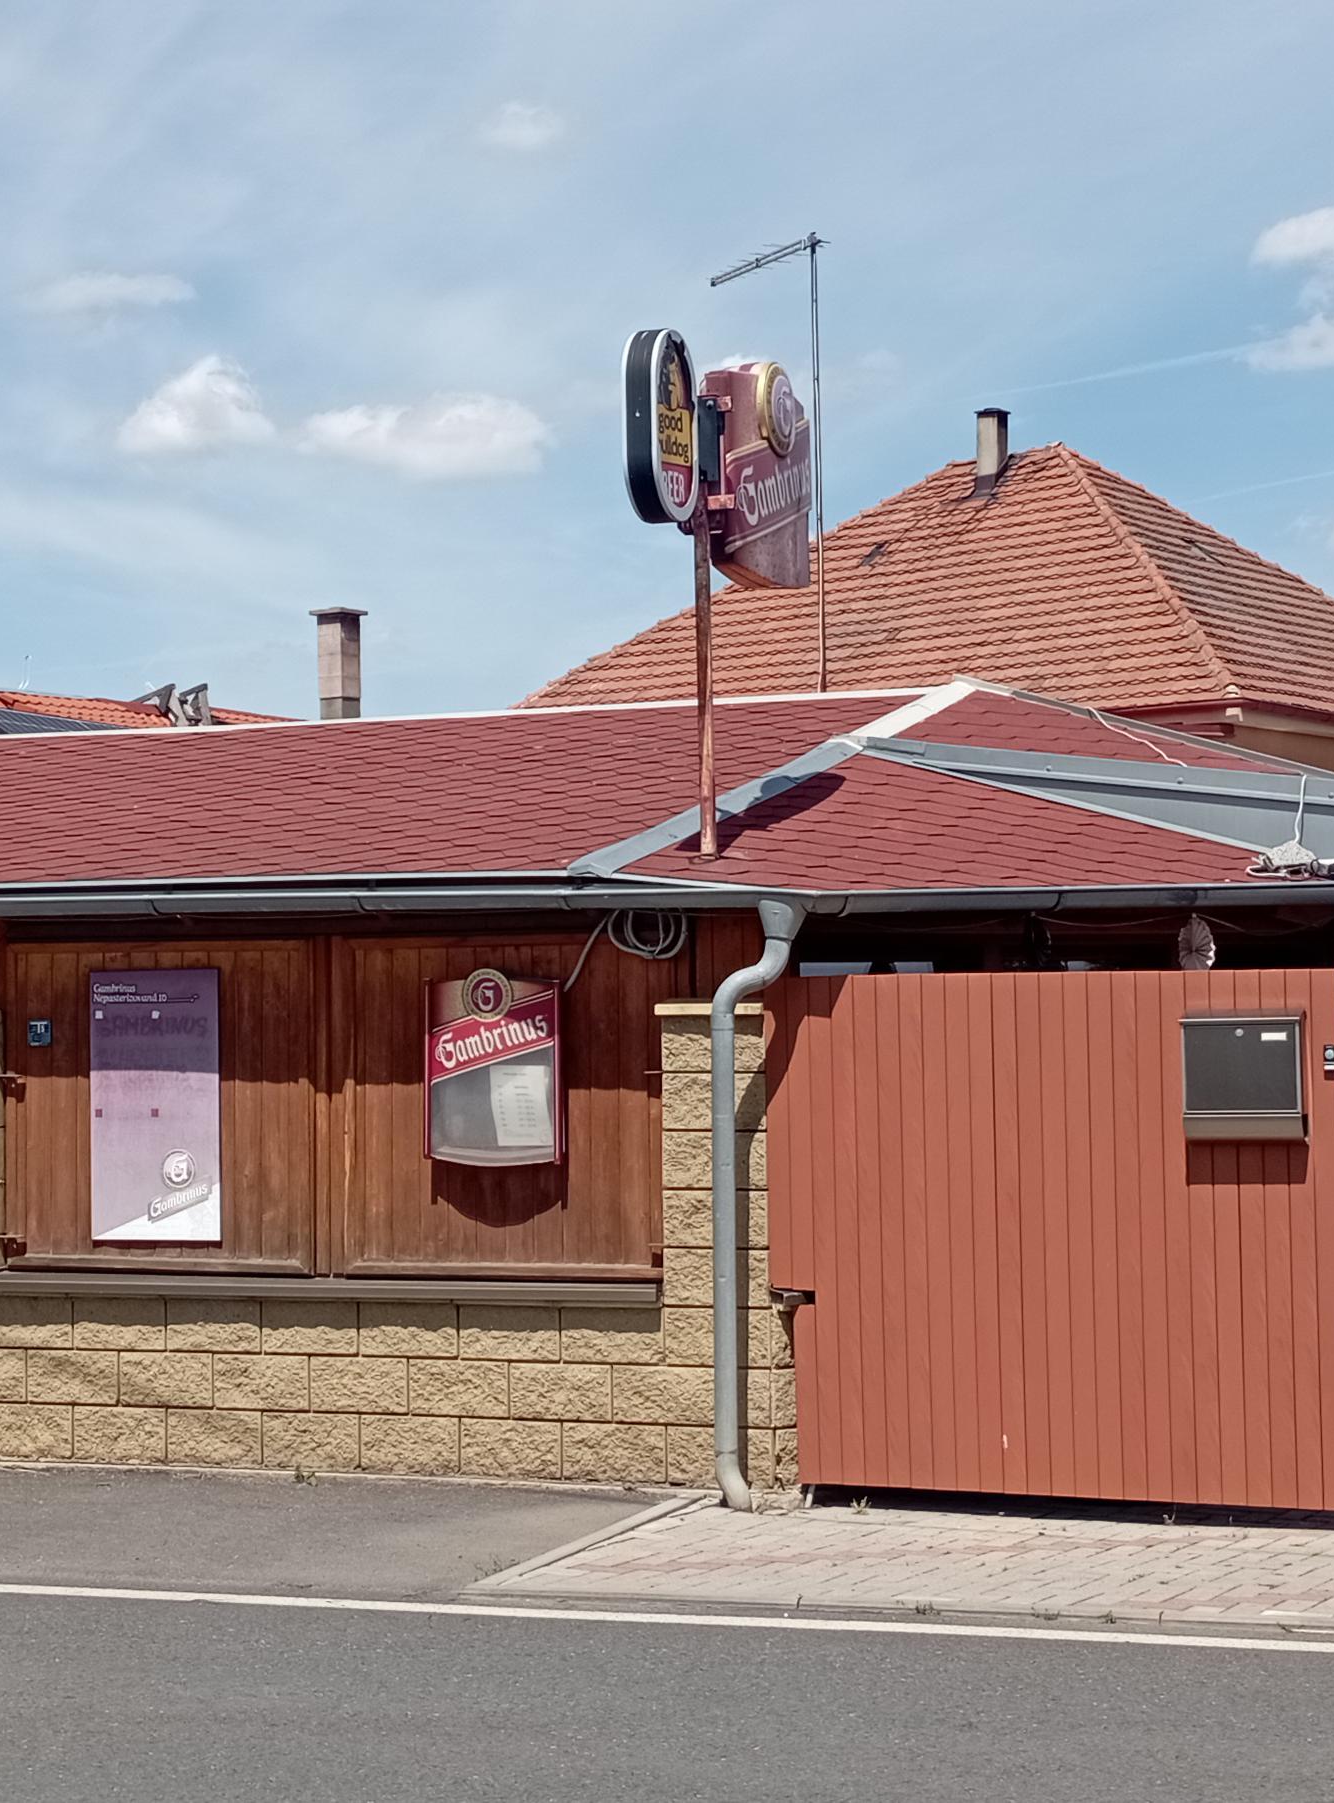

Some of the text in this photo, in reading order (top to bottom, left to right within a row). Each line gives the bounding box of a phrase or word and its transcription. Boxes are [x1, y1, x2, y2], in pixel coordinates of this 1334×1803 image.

[659, 412, 683, 433] good
[659, 434, 689, 463] ulldog
[735, 458, 811, 526] Gambrinus
[93, 984, 136, 993] Gambrinus
[435, 1015, 548, 1069] Gambrinus
[150, 1183, 208, 1218] Gambrinus
